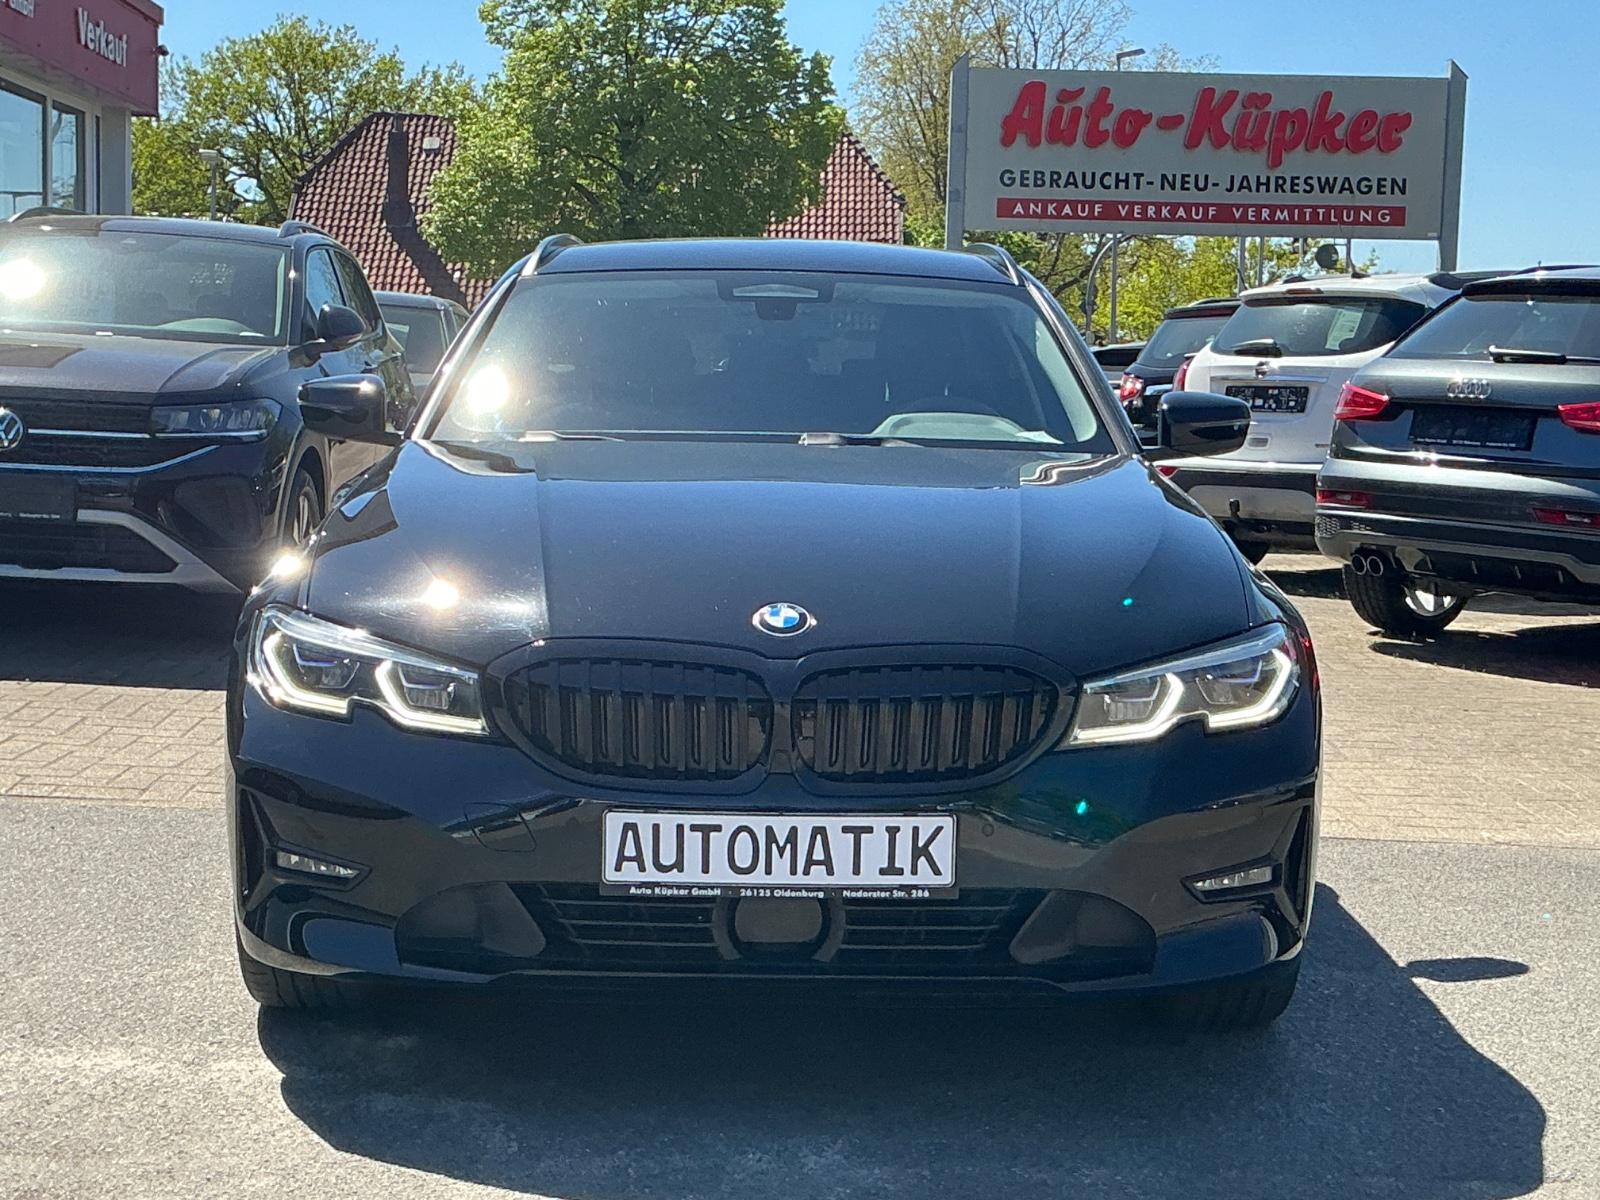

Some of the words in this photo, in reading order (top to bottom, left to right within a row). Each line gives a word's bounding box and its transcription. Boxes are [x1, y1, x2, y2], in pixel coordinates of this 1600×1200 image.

[78, 7, 127, 67] Verkauf
[1012, 202, 1103, 217] ANKAUF
[1118, 205, 1217, 220] VERKAUF
[1233, 207, 1391, 223] VERMITTLUNG
[614, 822, 944, 876] AUTOMATIK
[629, 886, 651, 894] Auto
[654, 886, 689, 896] Küpker
[691, 888, 721, 896] GmbH
[739, 888, 771, 897] 26125
[773, 889, 825, 899] Oldenburg
[892, 890, 908, 898] Str.
